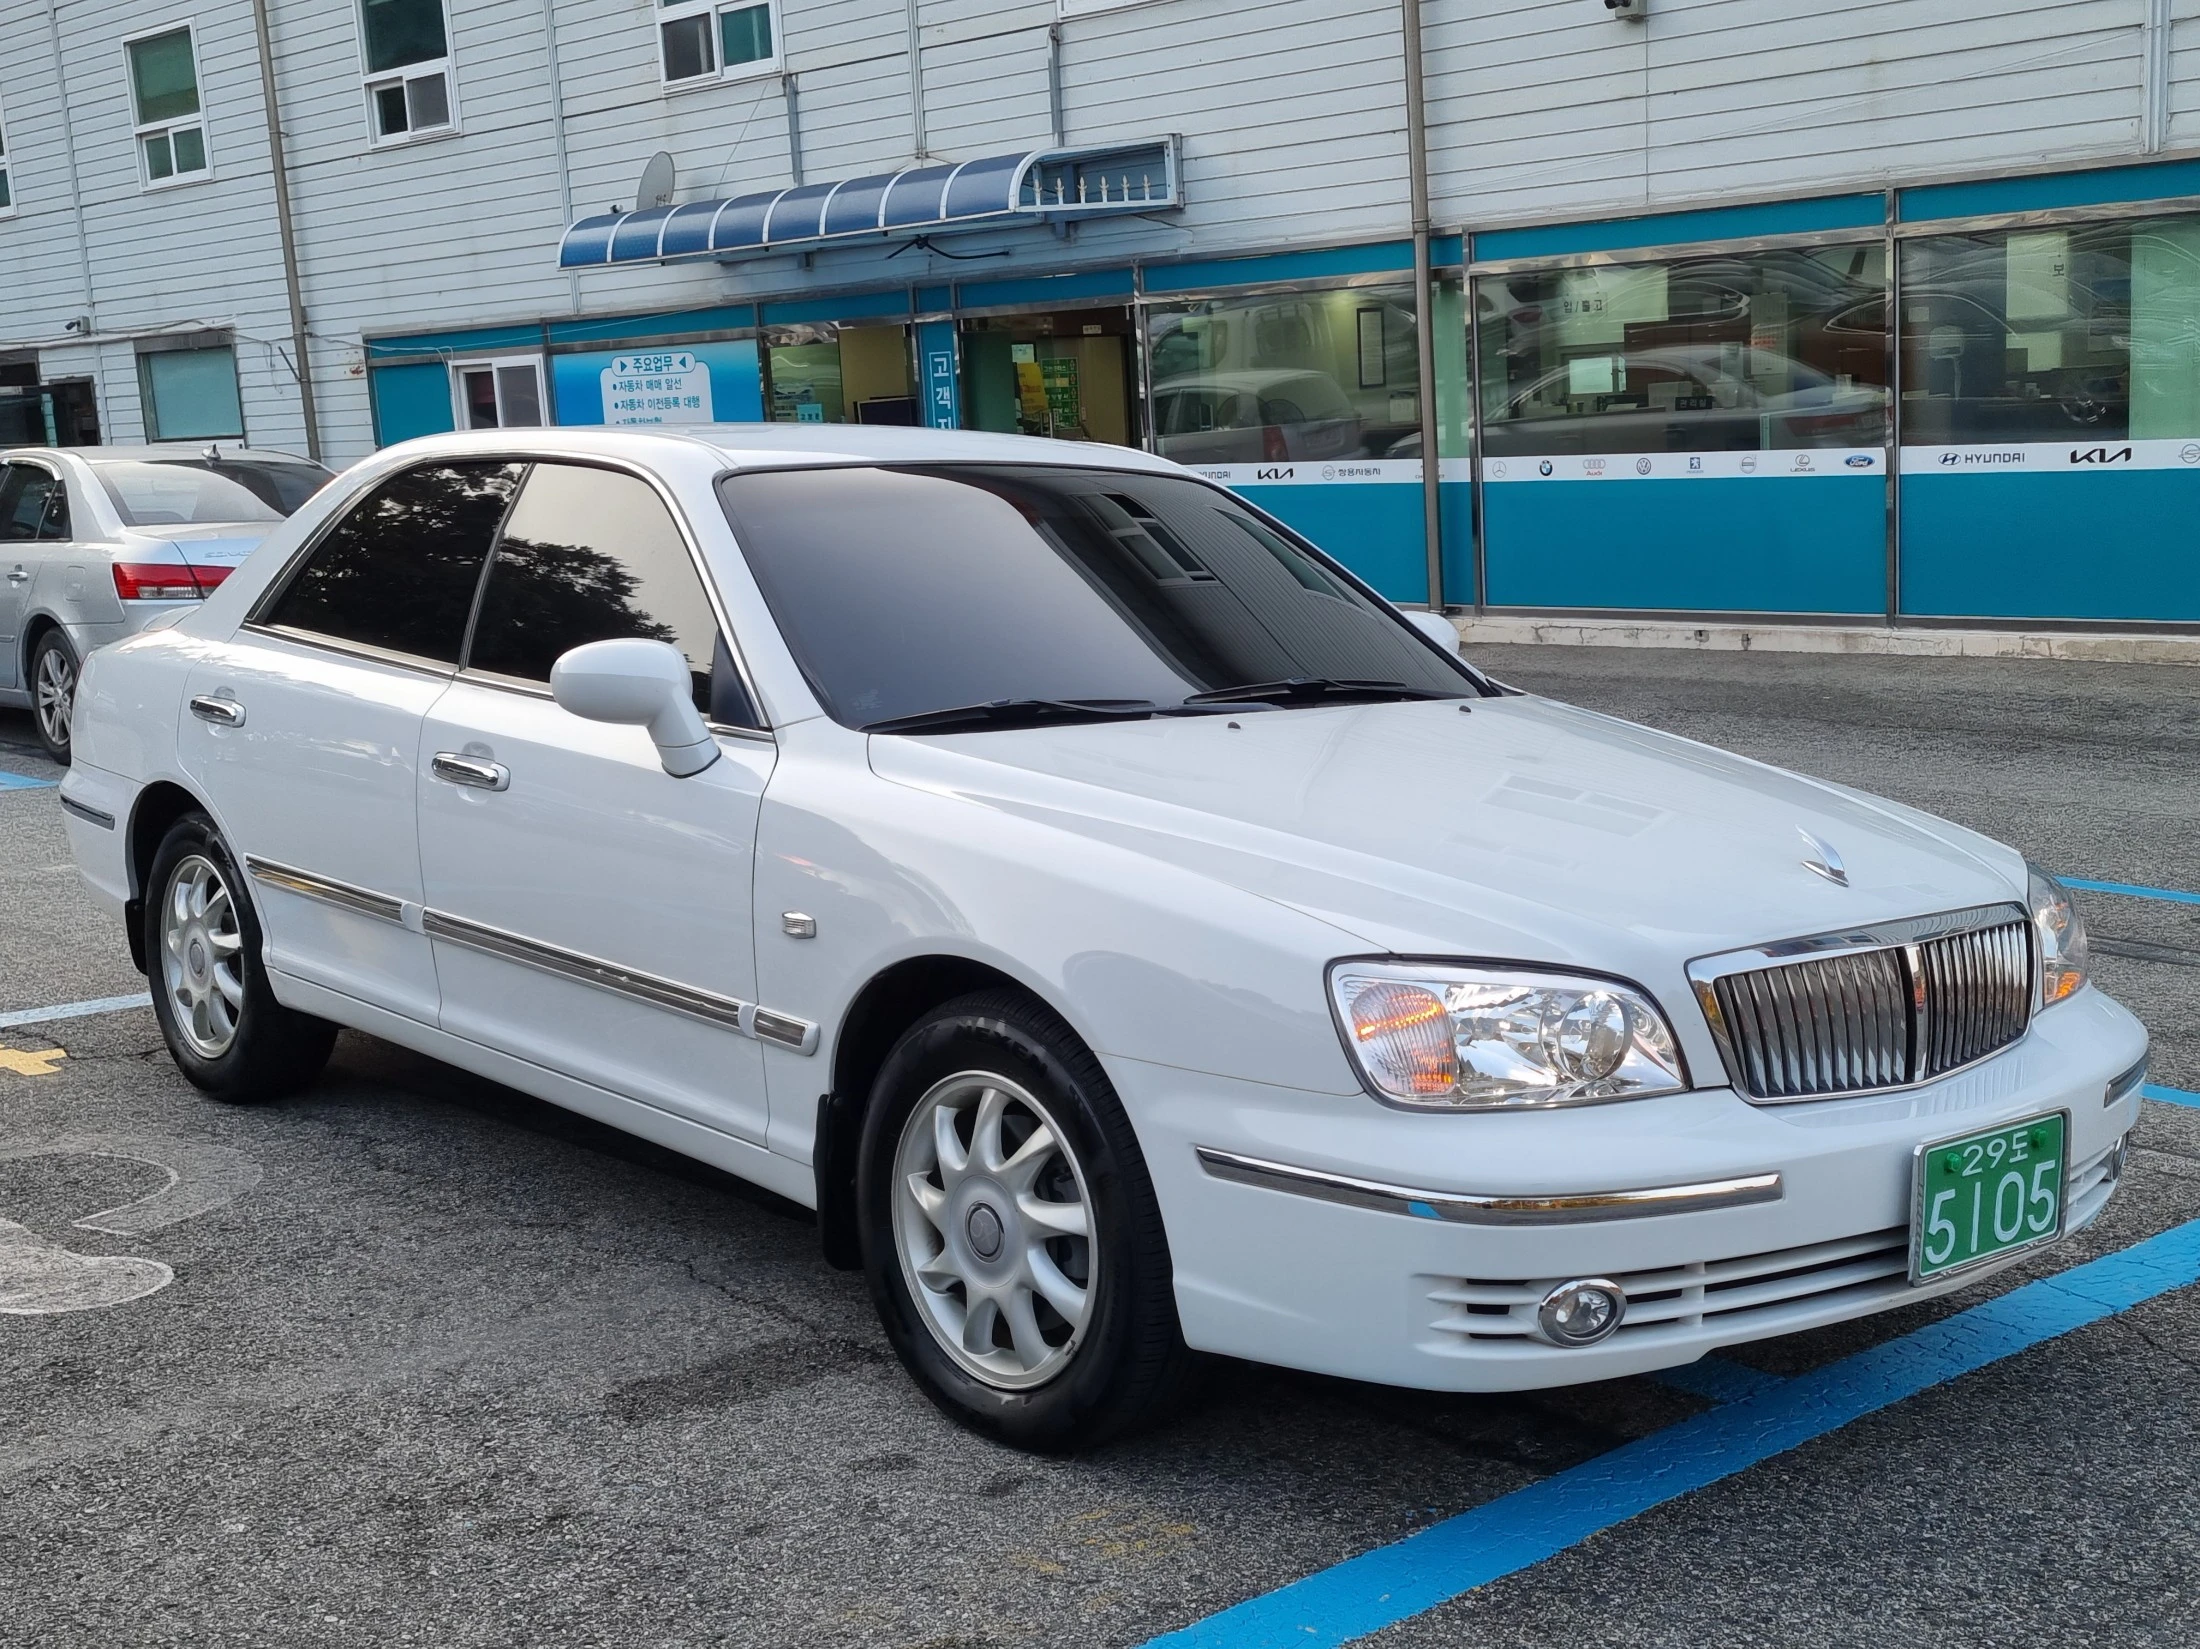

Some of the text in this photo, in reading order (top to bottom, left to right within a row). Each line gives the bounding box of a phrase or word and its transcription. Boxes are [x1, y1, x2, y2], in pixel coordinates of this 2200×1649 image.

[633, 356, 673, 373] 주요업무
[619, 378, 682, 393] 자동차 매매 알선
[620, 396, 701, 411] 자동차 이전등록 대행
[1964, 452, 2025, 464] HYUNDAI
[2070, 447, 2132, 464] KIA
[1257, 468, 1293, 480] KIA
[1338, 468, 1381, 477] 쌍용자동차
[1962, 1130, 2028, 1177] 29도
[1924, 1159, 2056, 1265] 5105
